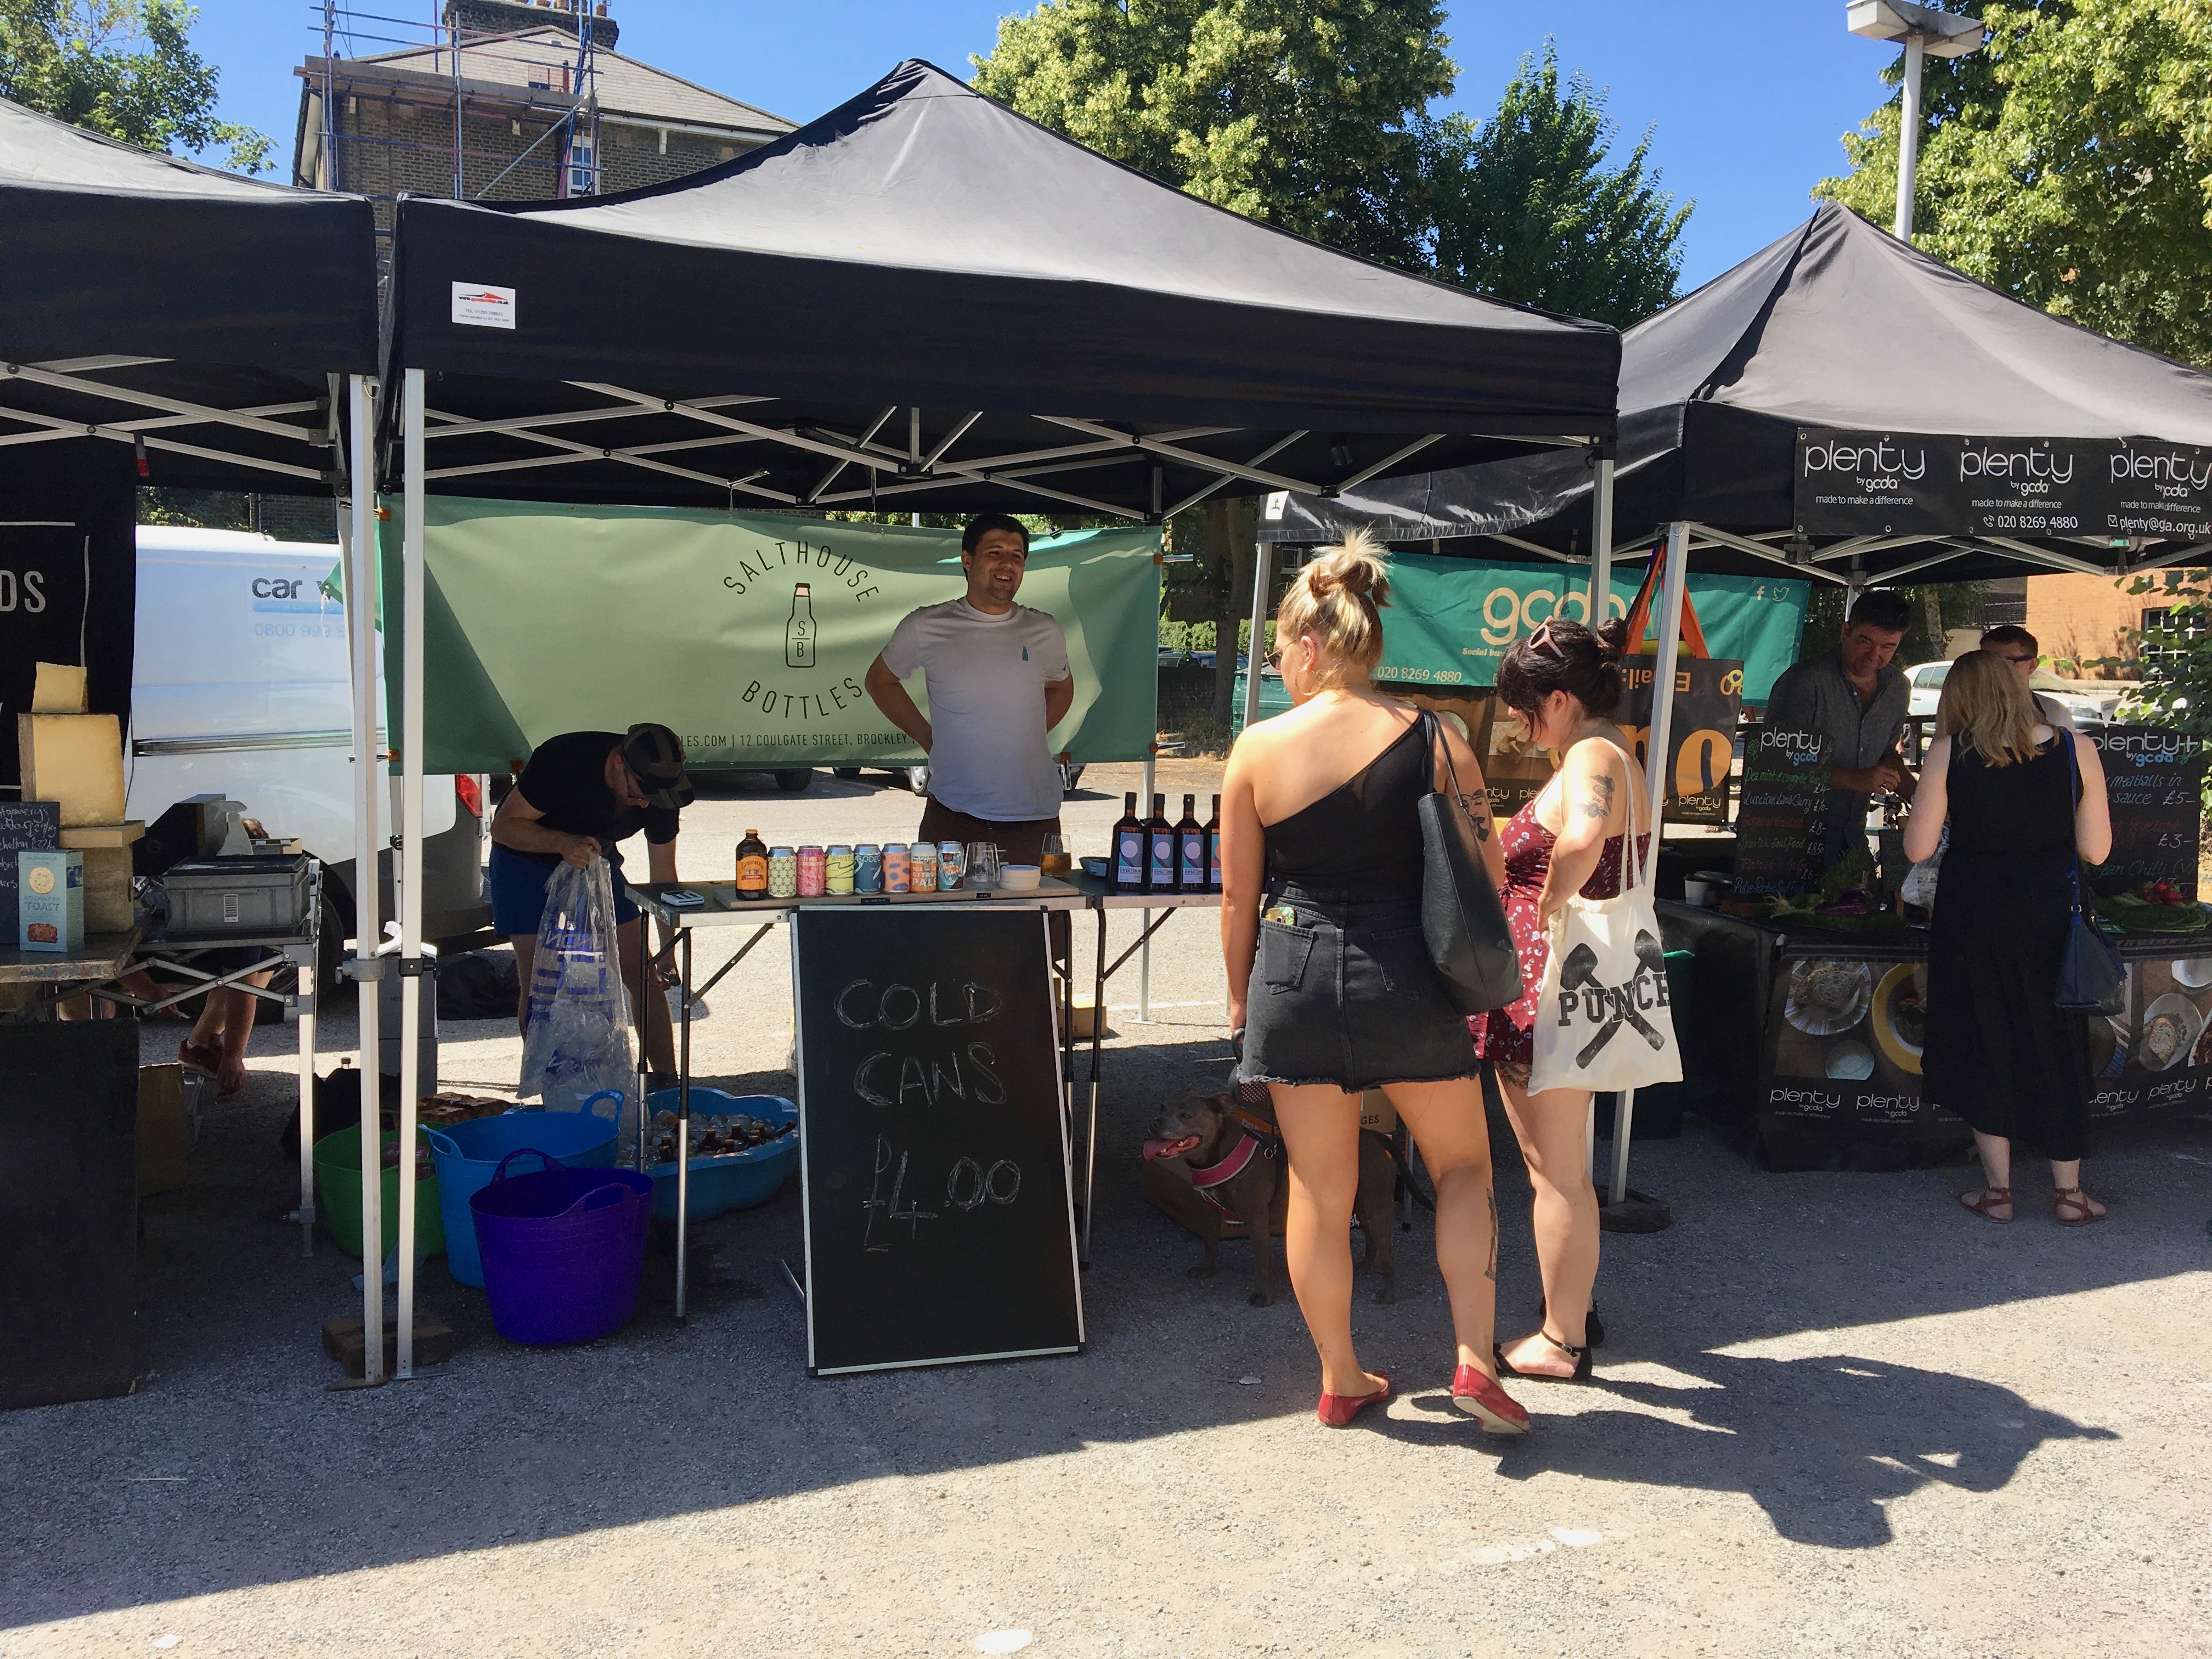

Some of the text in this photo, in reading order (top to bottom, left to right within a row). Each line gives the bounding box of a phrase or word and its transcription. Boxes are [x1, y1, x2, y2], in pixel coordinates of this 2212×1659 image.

[1804, 439, 1926, 479] plenty
[1960, 446, 2073, 484] plenty
[2110, 449, 2212, 490] plenty
[1856, 475, 1898, 493] by gcda
[2010, 479, 2048, 496] by gcda
[2154, 483, 2188, 499] by cda
[1816, 495, 1837, 504] made
[1847, 495, 1869, 504] make
[1875, 495, 1914, 505] difference
[1972, 498, 1994, 507] made
[1995, 499, 2003, 507] to
[2004, 499, 2022, 508] make
[2028, 499, 2062, 509] difference
[2120, 500, 2140, 509] made
[2140, 501, 2148, 509] to
[1997, 515, 2079, 528] 020 8269 4880
[724, 540, 879, 602] SALTHOUSE
[252, 578, 303, 599] car
[254, 624, 296, 636] 0800
[798, 620, 806, 637] S
[797, 641, 805, 658] B
[1378, 667, 1462, 682] 020 8269 4880
[1621, 668, 1691, 693] Eail:
[741, 677, 863, 720] BOTTLES
[681, 733, 907, 747] LES.COM 12 COULGATE STREET, BROCKLEY
[1760, 726, 1822, 755] plenty
[1786, 749, 1794, 760] by
[2126, 749, 2174, 768] by gcda
[1485, 787, 1510, 800] nty
[2113, 792, 2152, 805] sauce
[24, 901, 60, 911] TOAST
[834, 978, 1004, 1030] COLD
[1558, 972, 1671, 1027] PUNCH
[854, 1041, 1007, 1107] CANS
[1769, 1087, 1841, 1108] plenty
[1856, 1093, 1920, 1112] plenty
[2089, 1090, 2140, 1103] enty
[1362, 1115, 1380, 1125] GES
[863, 1132, 1022, 1252] £4.00
